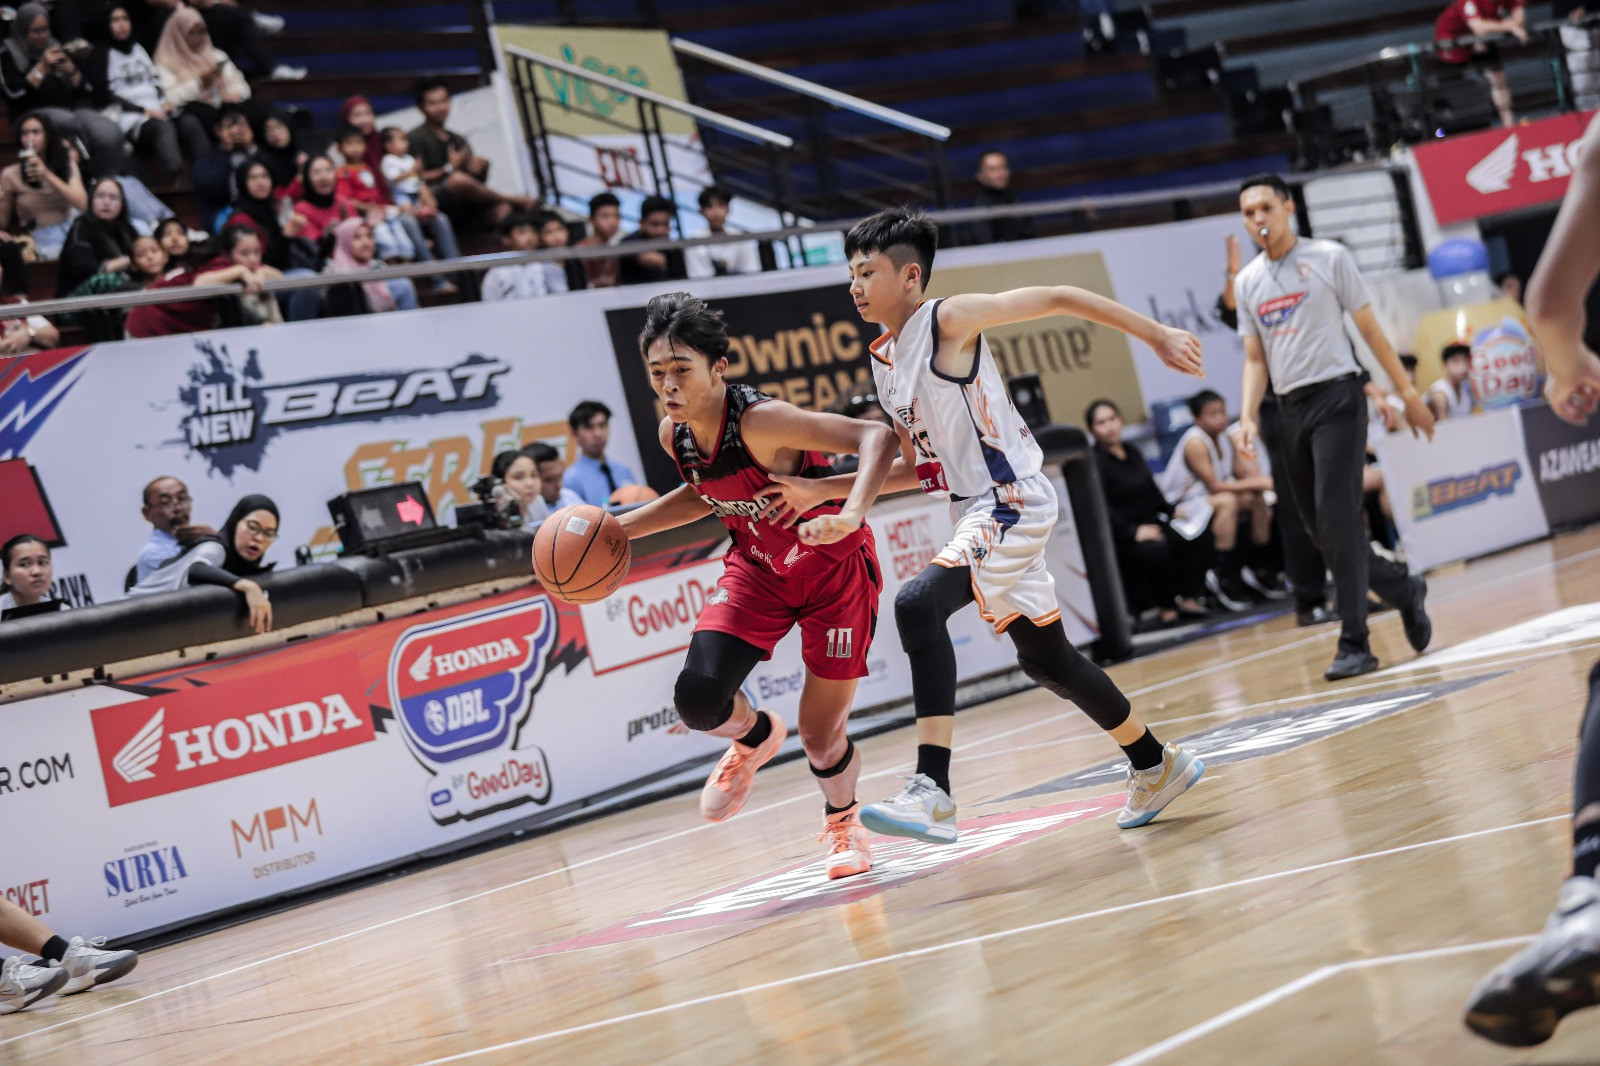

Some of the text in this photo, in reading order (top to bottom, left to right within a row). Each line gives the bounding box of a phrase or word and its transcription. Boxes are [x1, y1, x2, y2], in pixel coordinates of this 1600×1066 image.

[198, 382, 254, 414] ALL
[190, 409, 256, 447] NEW
[434, 638, 521, 676] HONDA
[826, 627, 853, 658] 10
[445, 688, 491, 731] DBL
[169, 693, 363, 771] HONDA
[231, 797, 323, 859] MPM
[104, 845, 188, 898] SURYA
[253, 851, 316, 879] DISTRIBUTOR
